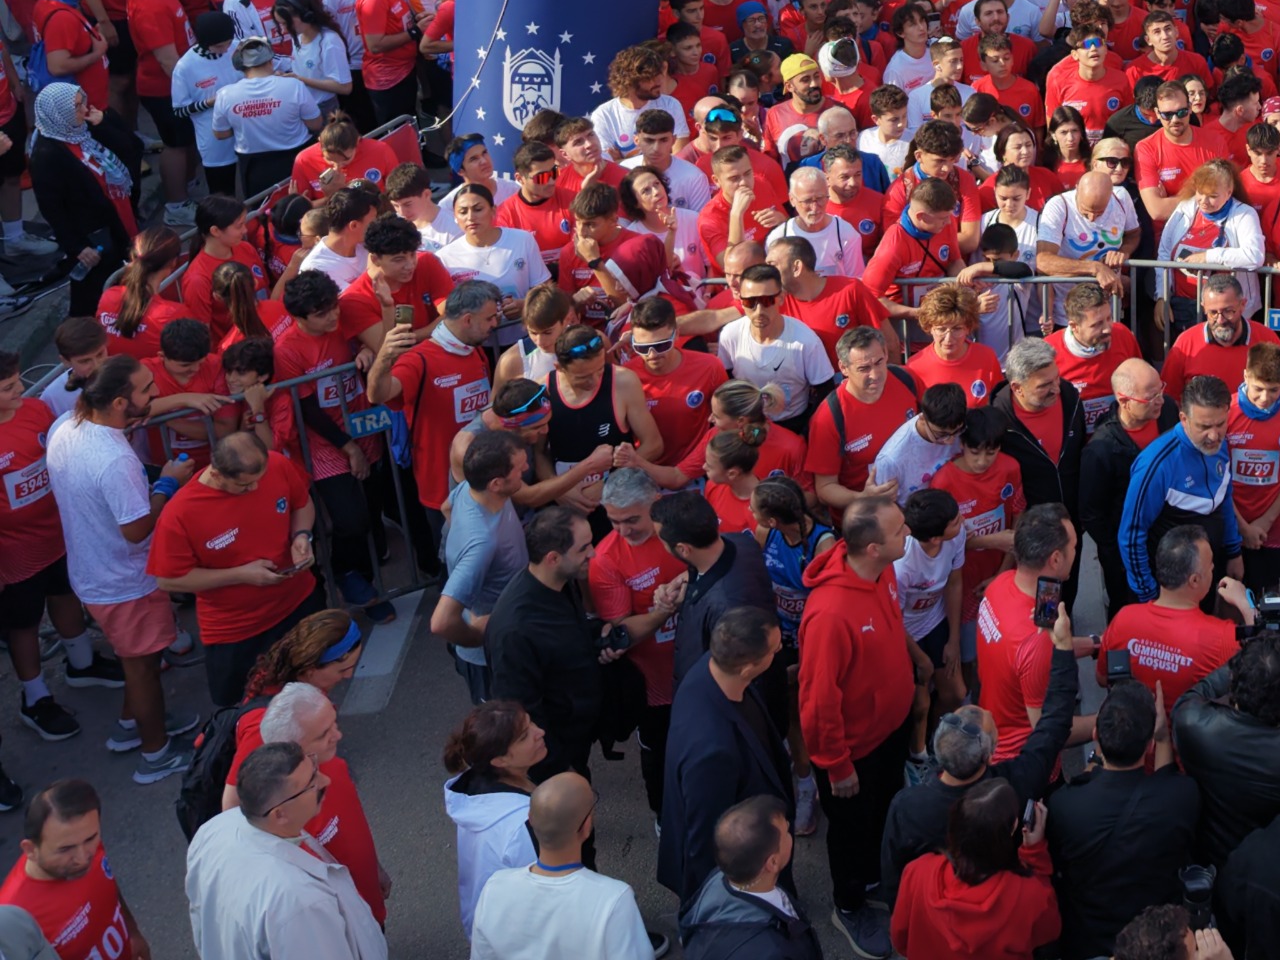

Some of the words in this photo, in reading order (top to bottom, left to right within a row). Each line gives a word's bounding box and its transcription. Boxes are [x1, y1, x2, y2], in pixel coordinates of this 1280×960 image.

[242, 109, 272, 118] KOŞUSU
[325, 377, 356, 399] 270
[1240, 463, 1271, 478] 1799
[20, 471, 49, 497] 3945
[1127, 638, 1194, 668] CUMHURİYET
[1138, 654, 1179, 673] KOŞUSU
